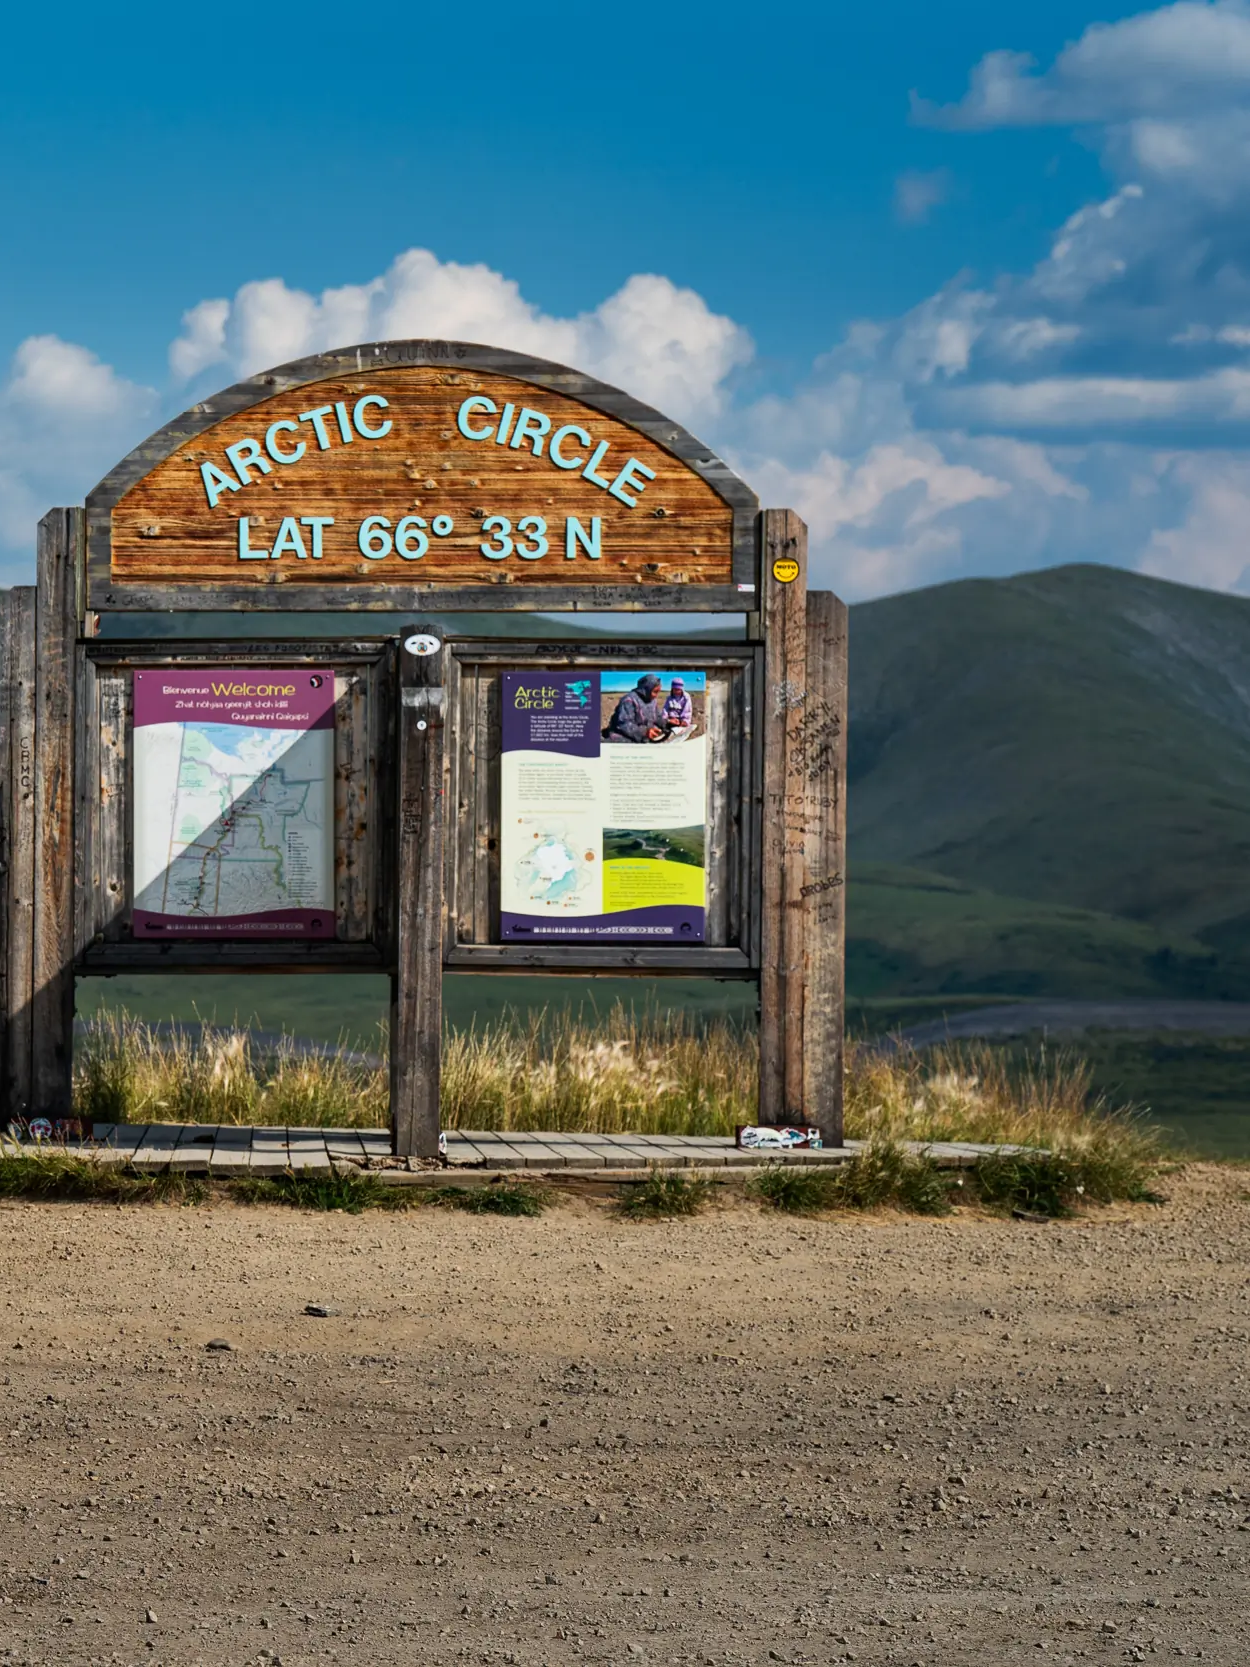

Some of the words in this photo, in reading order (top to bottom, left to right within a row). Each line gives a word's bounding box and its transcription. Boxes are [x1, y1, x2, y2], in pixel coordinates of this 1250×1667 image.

[200, 394, 393, 508] ARCTIC
[458, 395, 657, 508] CIRCLE
[239, 516, 335, 560] LAT
[358, 516, 453, 560] 66°
[481, 516, 549, 560] 33
[566, 517, 602, 560] N
[162, 685, 209, 695] Bienvenue
[211, 682, 296, 696] Welcome
[514, 685, 561, 698] Arctic
[514, 696, 554, 709] Circle
